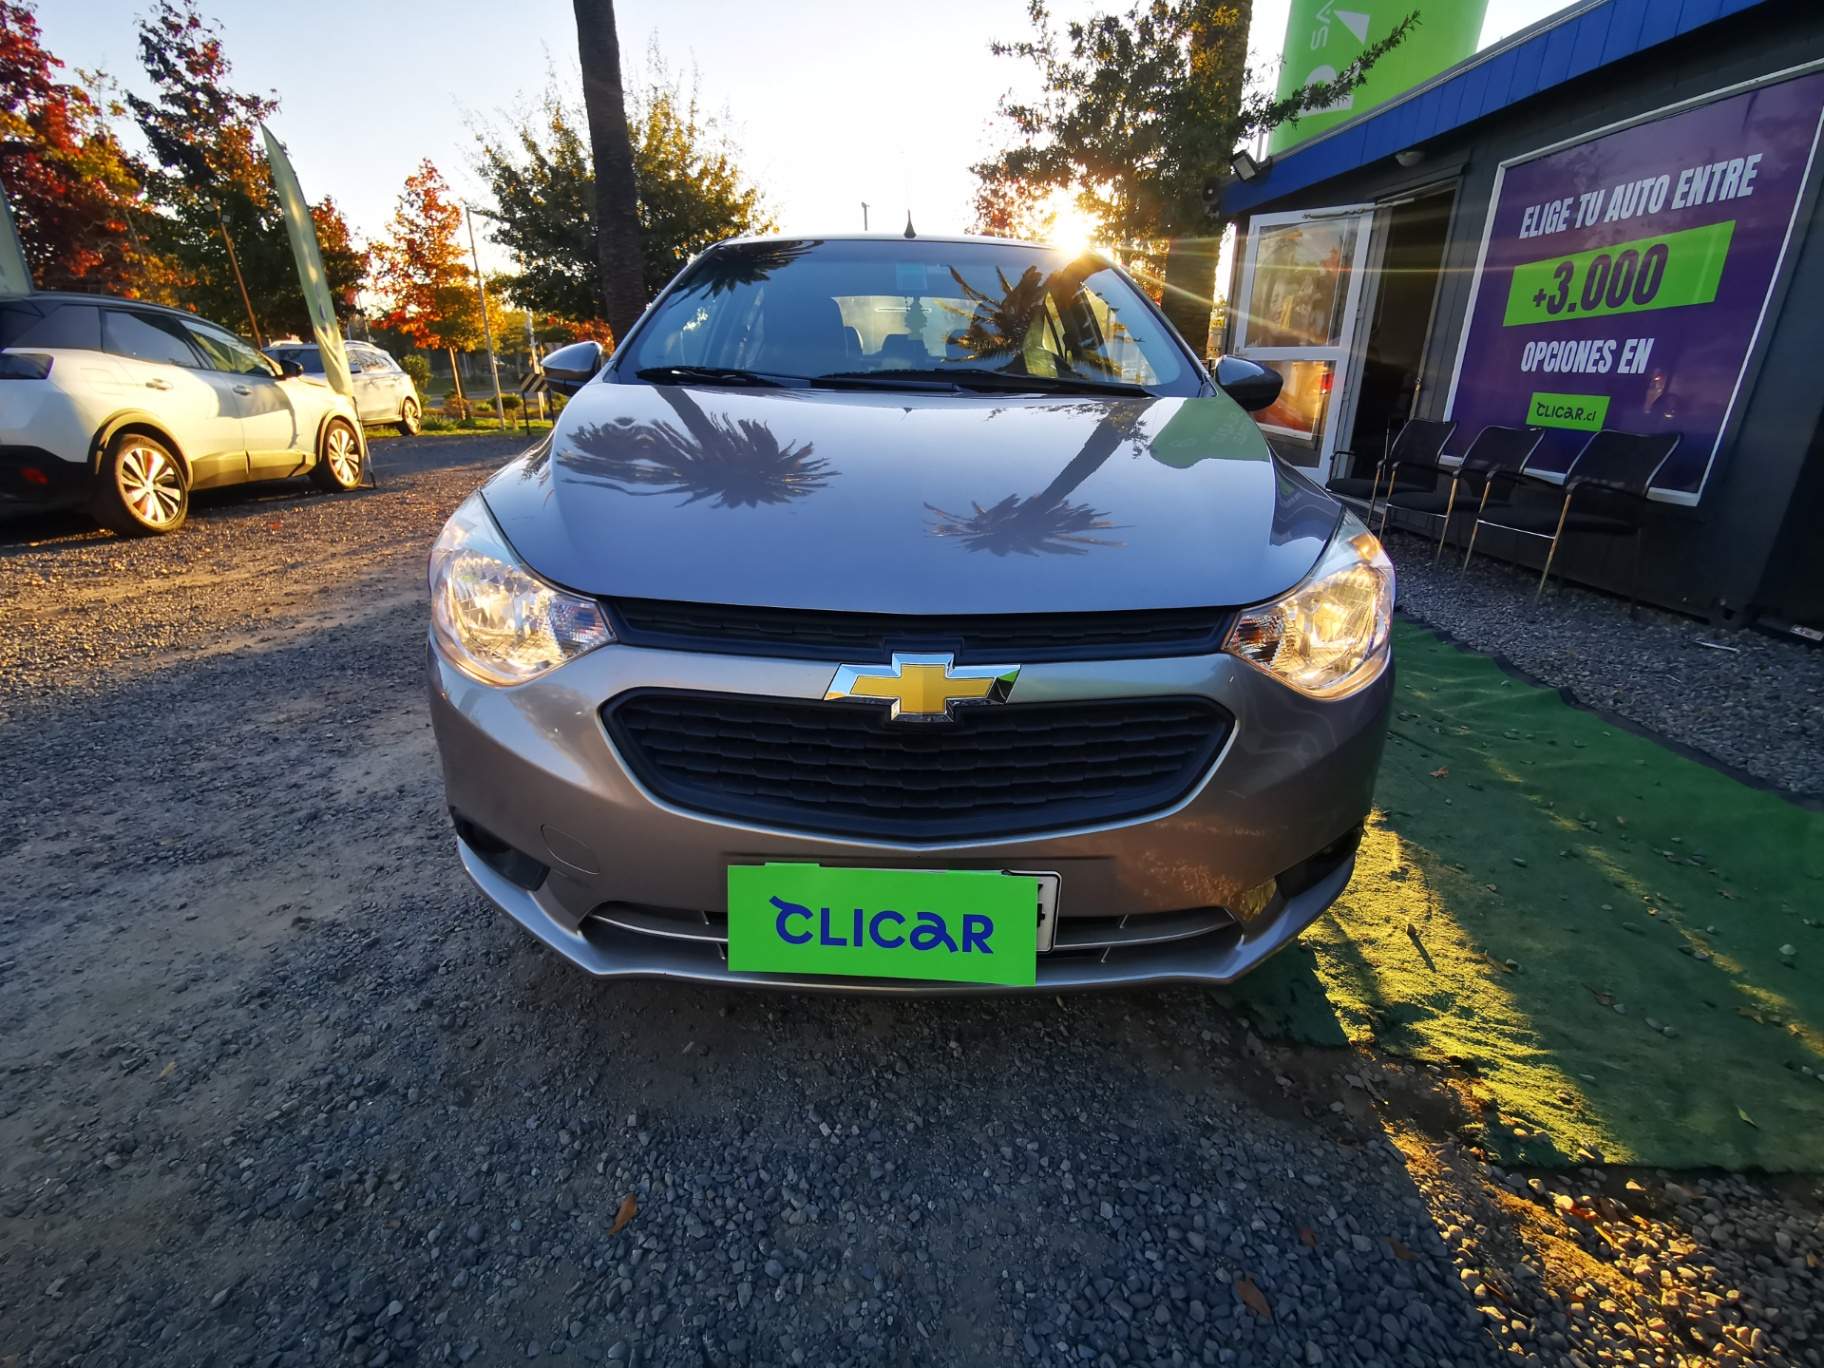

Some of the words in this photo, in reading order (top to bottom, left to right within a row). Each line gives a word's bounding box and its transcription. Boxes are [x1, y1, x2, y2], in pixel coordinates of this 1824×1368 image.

[1519, 197, 1574, 240] ELIGE
[1575, 189, 1606, 229] TU
[1604, 174, 1671, 223] AUTO
[1671, 153, 1763, 210] ENTRE
[1533, 243, 1669, 315] +3.000
[1520, 339, 1616, 374] OPCIONES
[1617, 338, 1654, 374] EN
